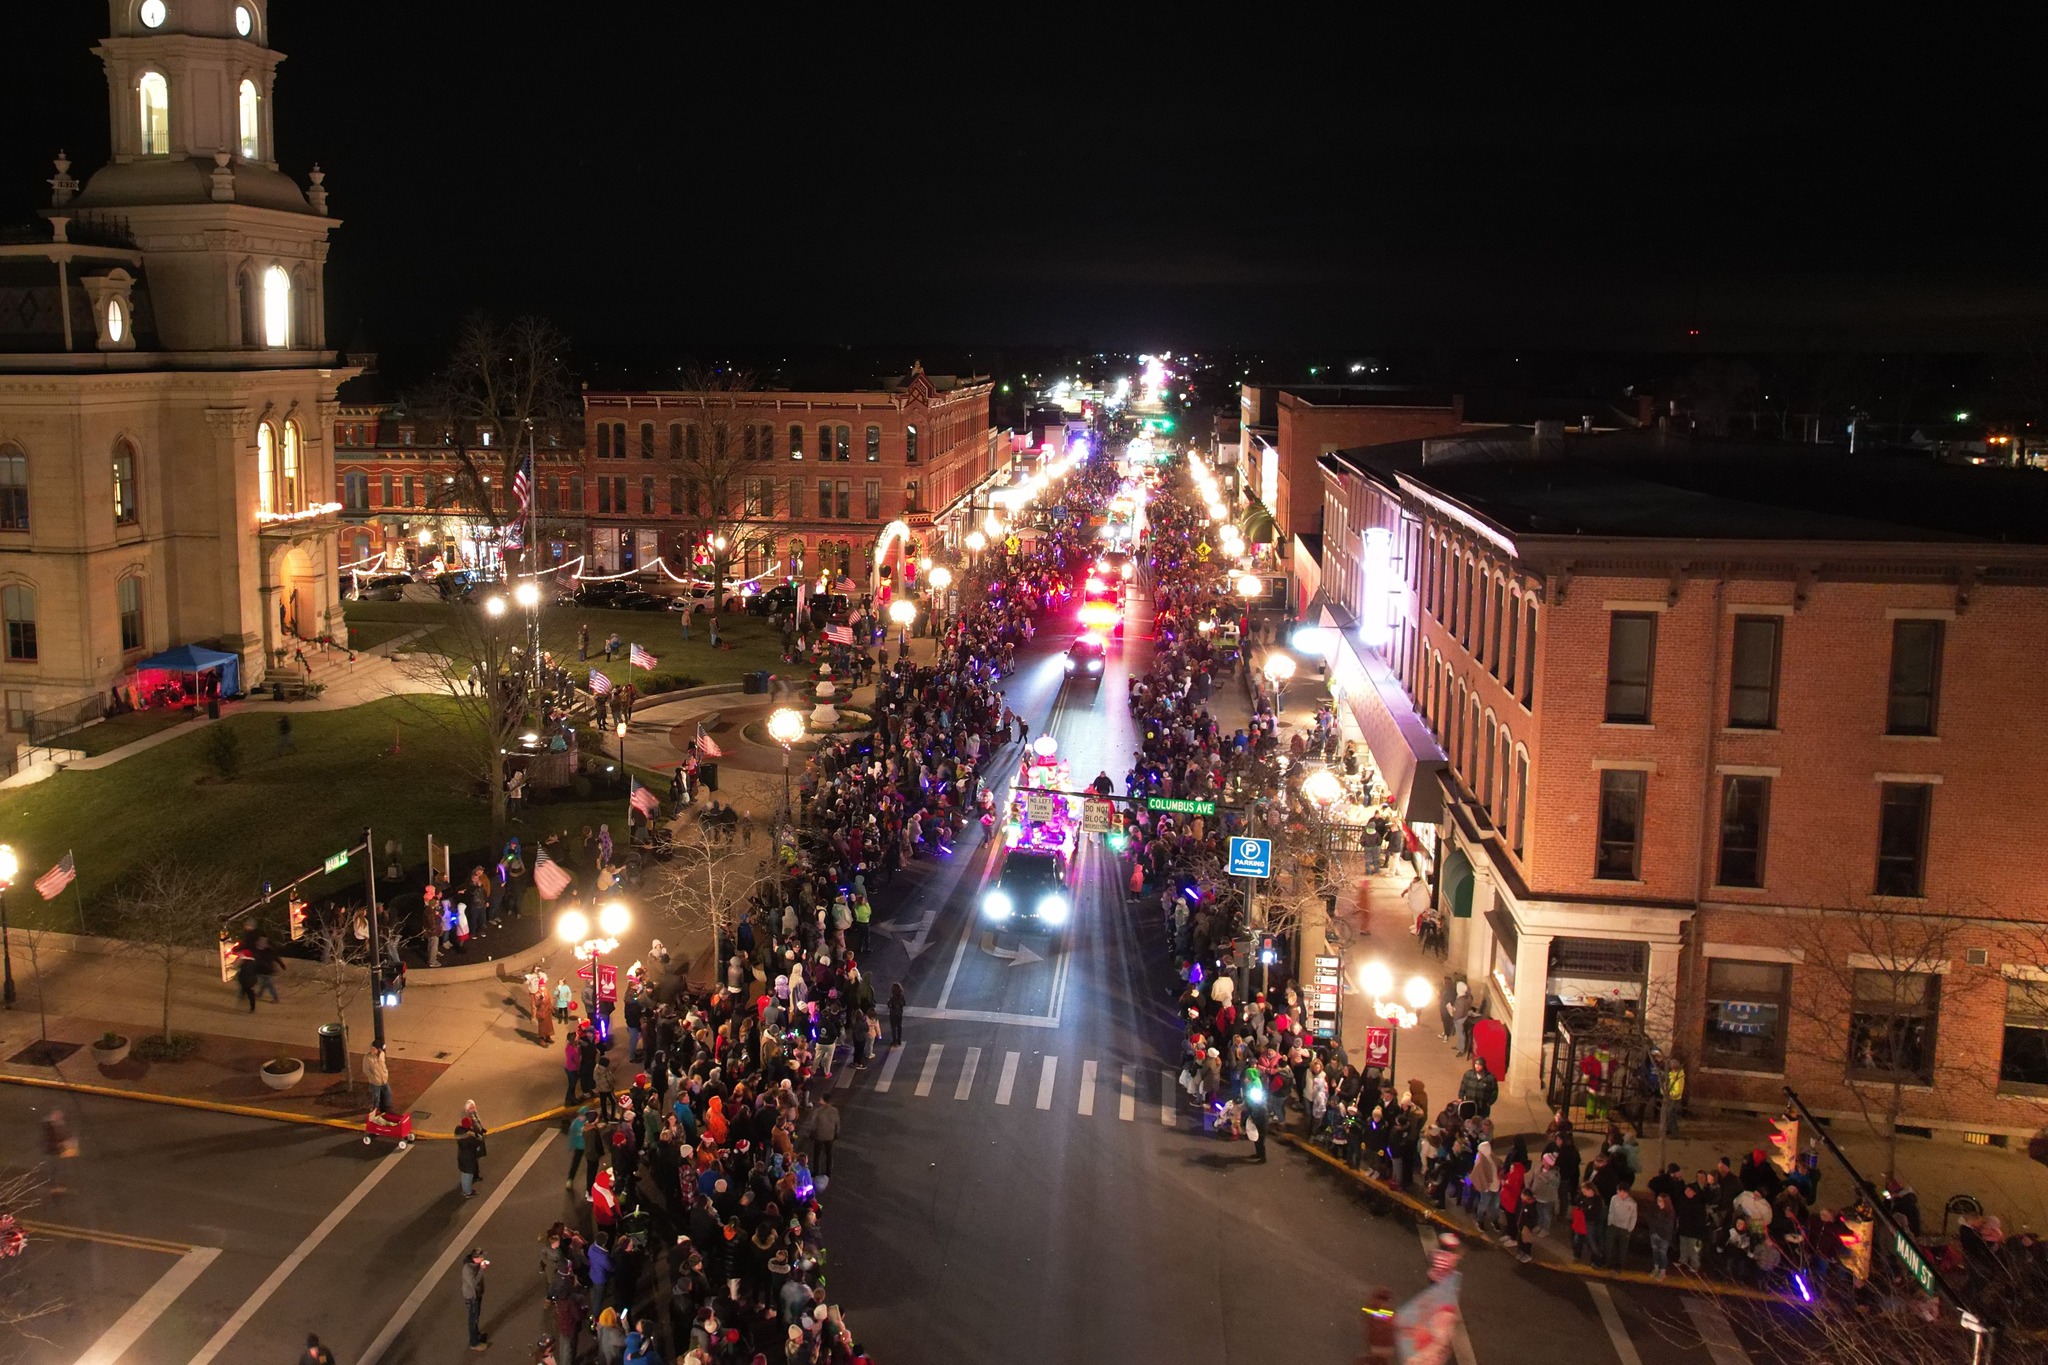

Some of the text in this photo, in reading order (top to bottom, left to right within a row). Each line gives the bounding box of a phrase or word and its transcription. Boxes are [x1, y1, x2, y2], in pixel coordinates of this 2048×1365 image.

[1150, 799, 1213, 814] COLUMBUS AVE
[1234, 859, 1265, 867] PARKING
[1897, 1234, 1932, 1290] MAIN ST
